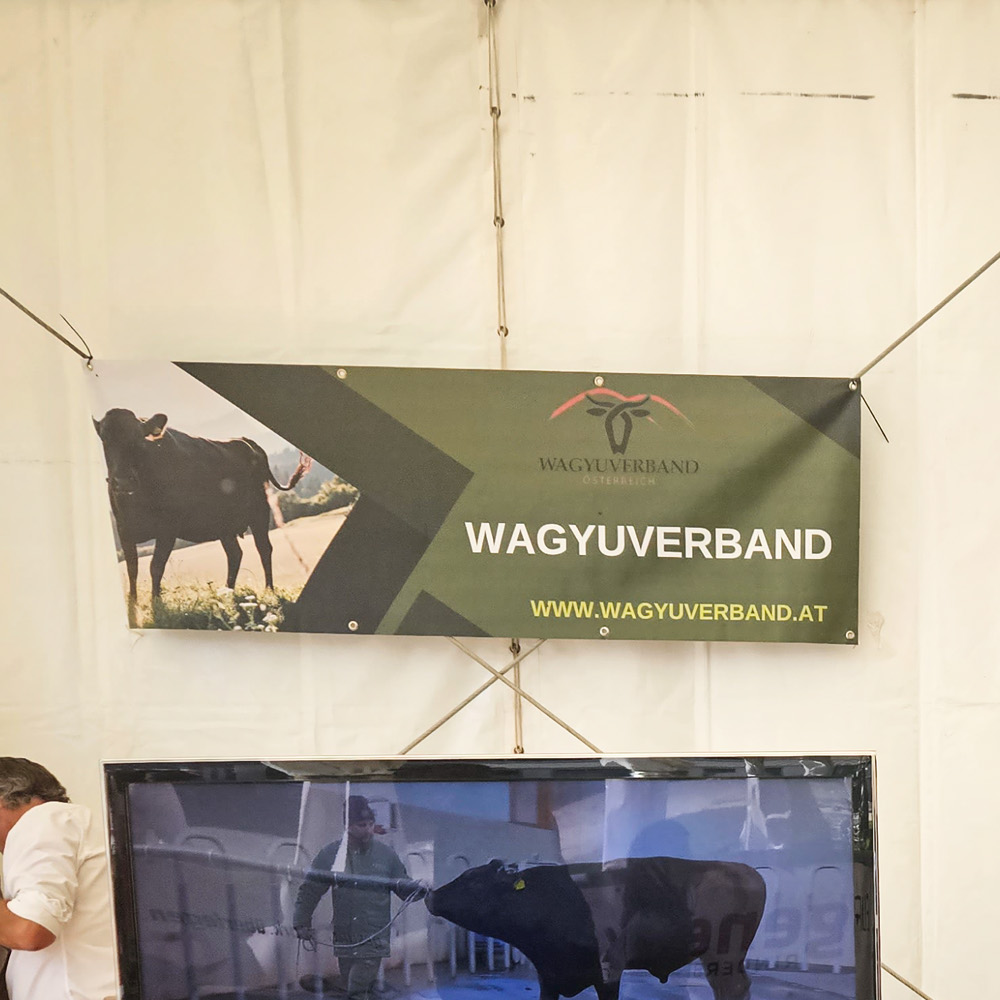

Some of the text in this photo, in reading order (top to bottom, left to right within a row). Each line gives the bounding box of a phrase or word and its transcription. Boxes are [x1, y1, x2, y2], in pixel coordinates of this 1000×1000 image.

[538, 457, 700, 474] WAGYUVERBAND
[582, 475, 656, 486] ÖSTERREICH
[465, 521, 832, 561] WAGYUVERBAND
[530, 598, 828, 624] WWW.WAGYUVERBAND.AT
